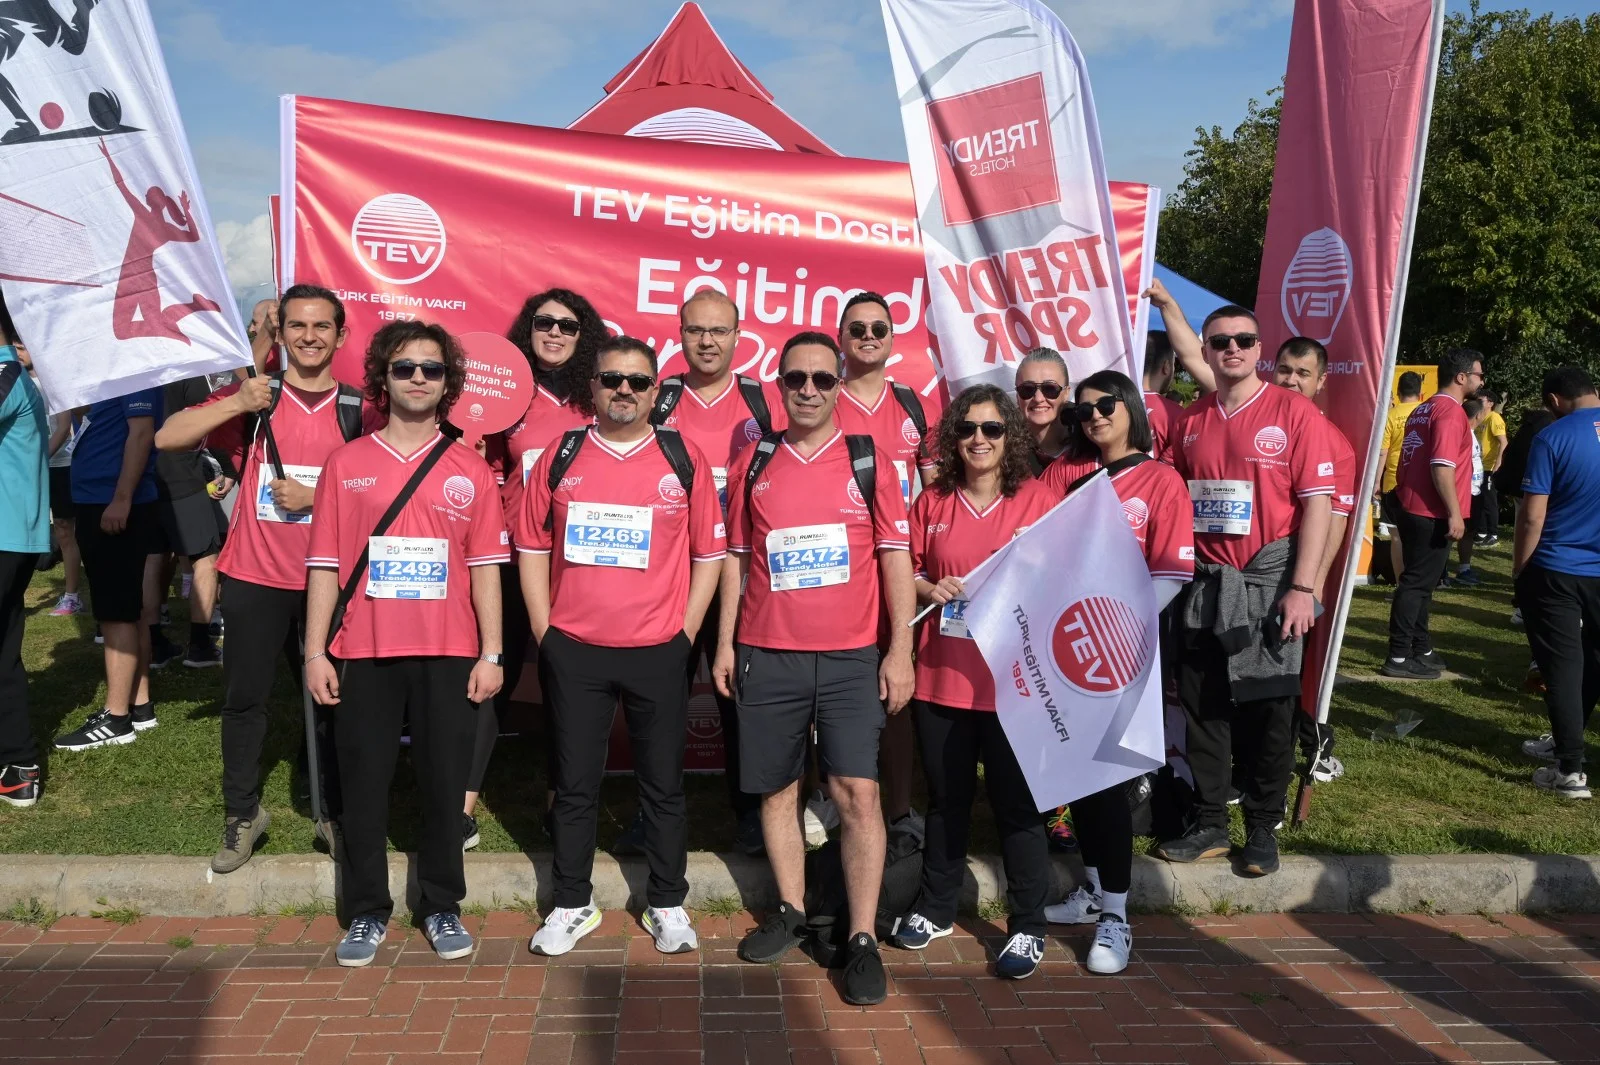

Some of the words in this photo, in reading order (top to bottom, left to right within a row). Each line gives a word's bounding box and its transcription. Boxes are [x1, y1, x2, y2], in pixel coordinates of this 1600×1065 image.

[565, 184, 650, 222] TEV
[664, 195, 800, 239] Eğitim
[363, 240, 435, 265] TEV
[370, 292, 422, 307] EĞİTİM
[425, 298, 466, 311] VAKFI
[377, 310, 416, 321] 1967
[493, 364, 512, 376] için
[503, 379, 517, 389] da
[1258, 440, 1283, 450] TEV
[342, 476, 377, 489] TRENDY
[447, 489, 470, 503] TEV
[663, 488, 685, 497] TEV
[1195, 501, 1246, 514] 12482
[574, 526, 644, 544] 12469
[783, 536, 796, 546] 20
[386, 545, 400, 555] 20
[578, 540, 610, 548] Trendy
[775, 547, 843, 567] 12472
[375, 561, 443, 576] 12492
[780, 563, 811, 572] Trendy
[1063, 611, 1112, 685] TEV
[1012, 604, 1030, 645] TÜRK
[1023, 644, 1050, 699] EĞİTİM
[1044, 697, 1070, 743] VAKFI
[1012, 660, 1031, 697] 1967
